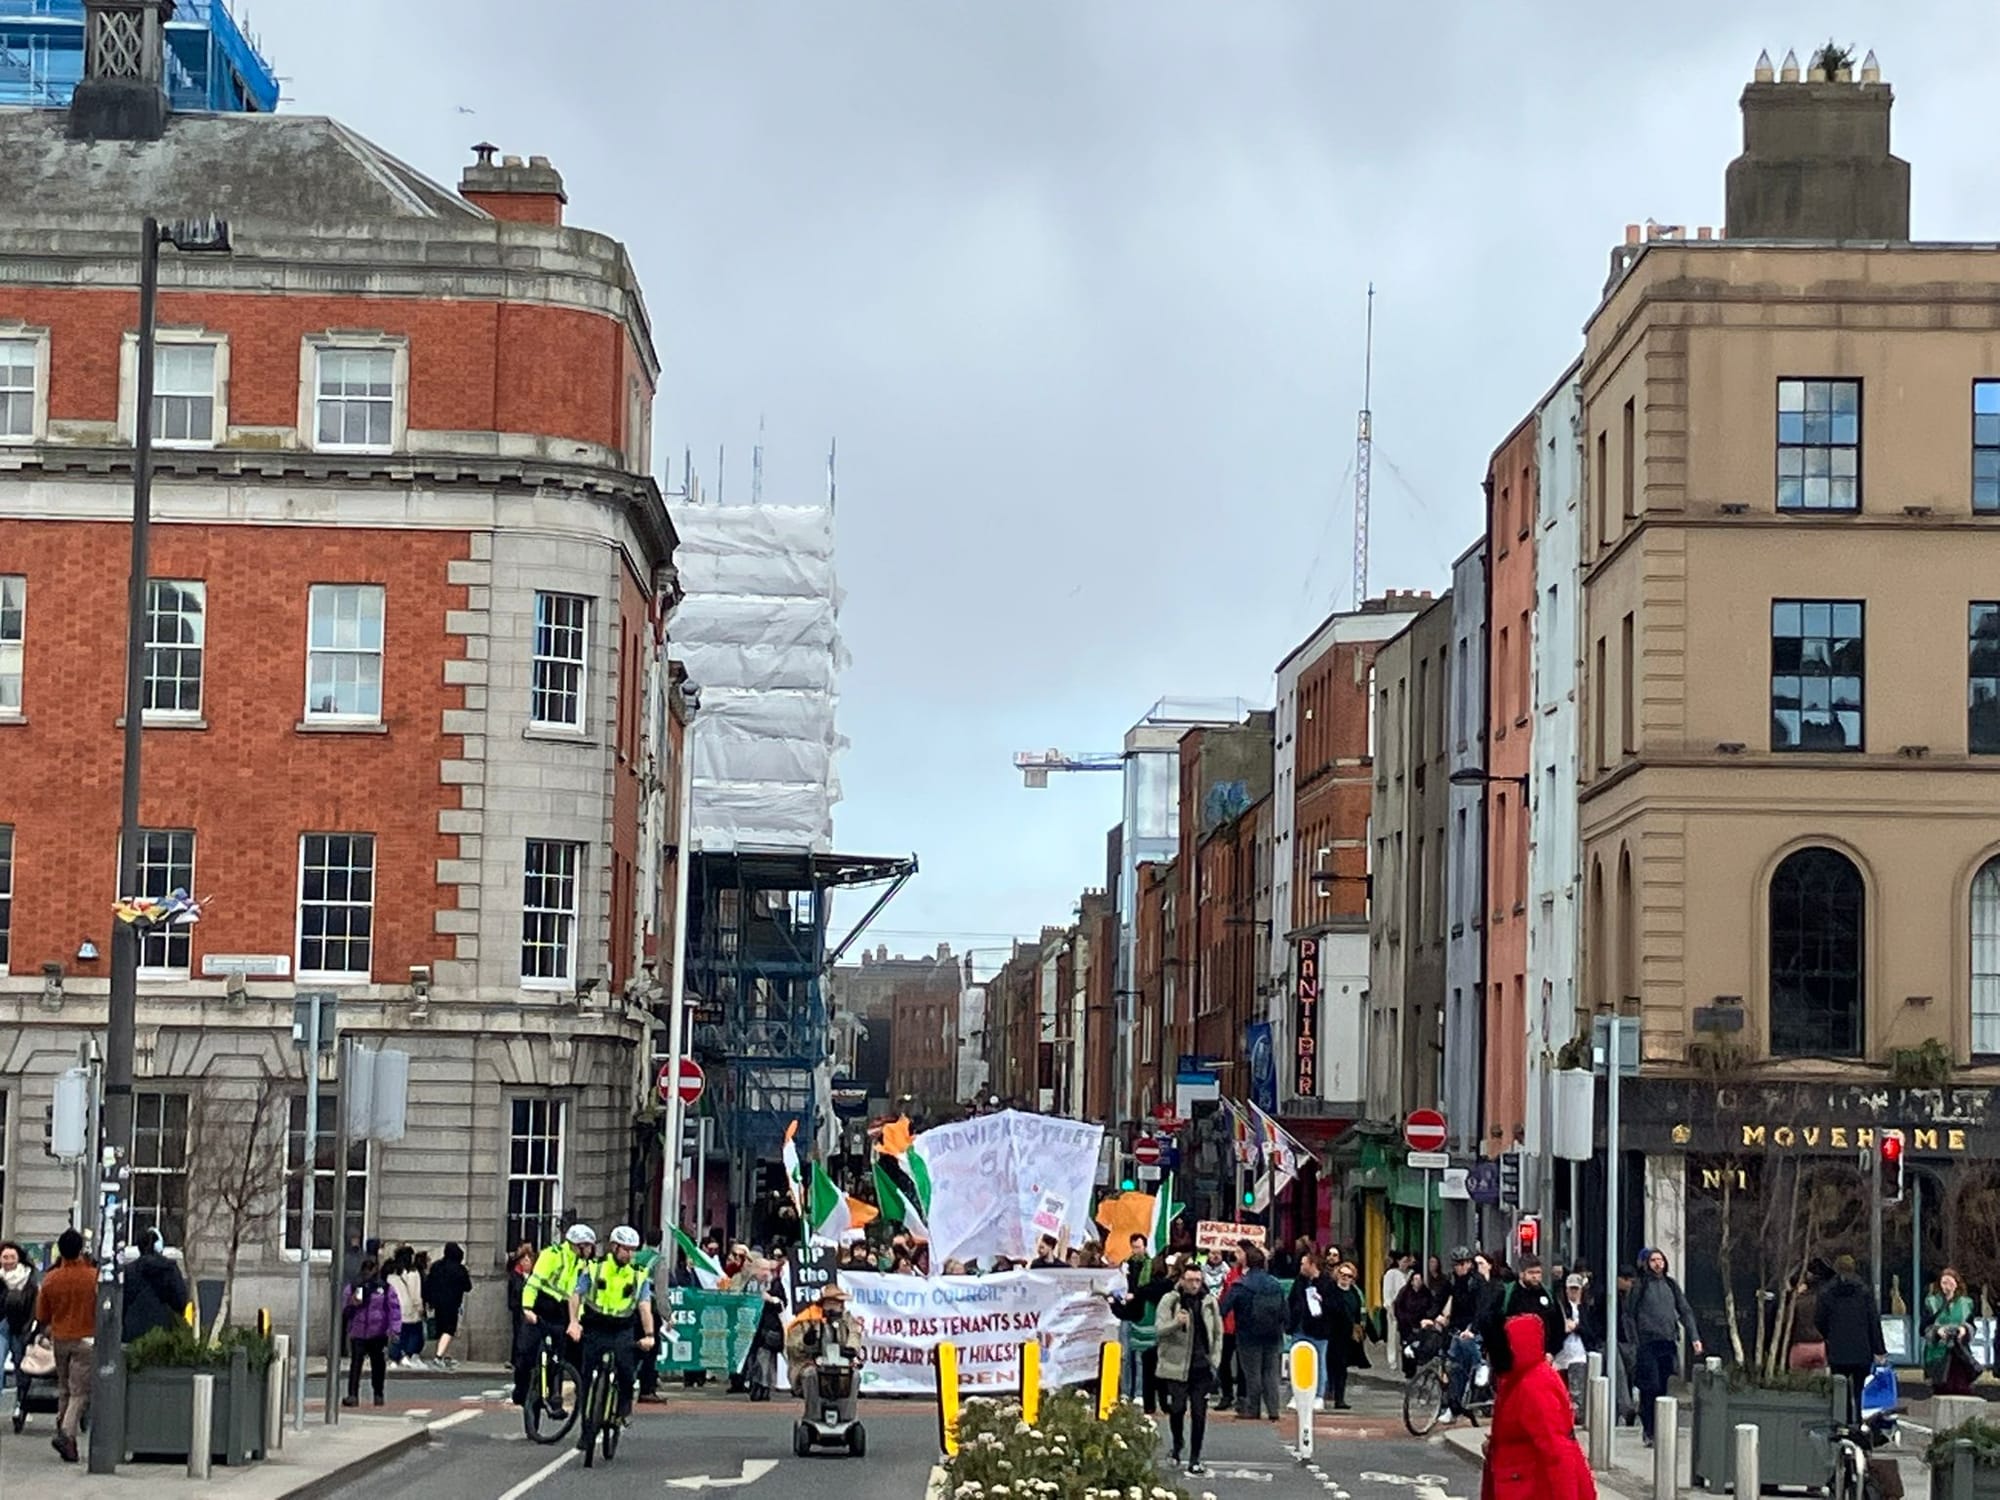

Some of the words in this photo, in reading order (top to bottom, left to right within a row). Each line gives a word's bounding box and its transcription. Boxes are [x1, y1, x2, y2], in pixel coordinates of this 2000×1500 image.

[1298, 939, 1317, 1095] PANTIBAR
[1742, 1125, 1966, 1151] MOVEHME
[795, 1286, 822, 1303] Fla
[893, 1290, 928, 1307] CITY
[909, 1316, 938, 1337] RAS
[941, 1312, 1010, 1336] TENANTS
[1012, 1310, 1042, 1331] SAY
[871, 1345, 924, 1365] UNFAIR
[926, 1346, 968, 1367] RT
[969, 1341, 1018, 1365] HIKES!
